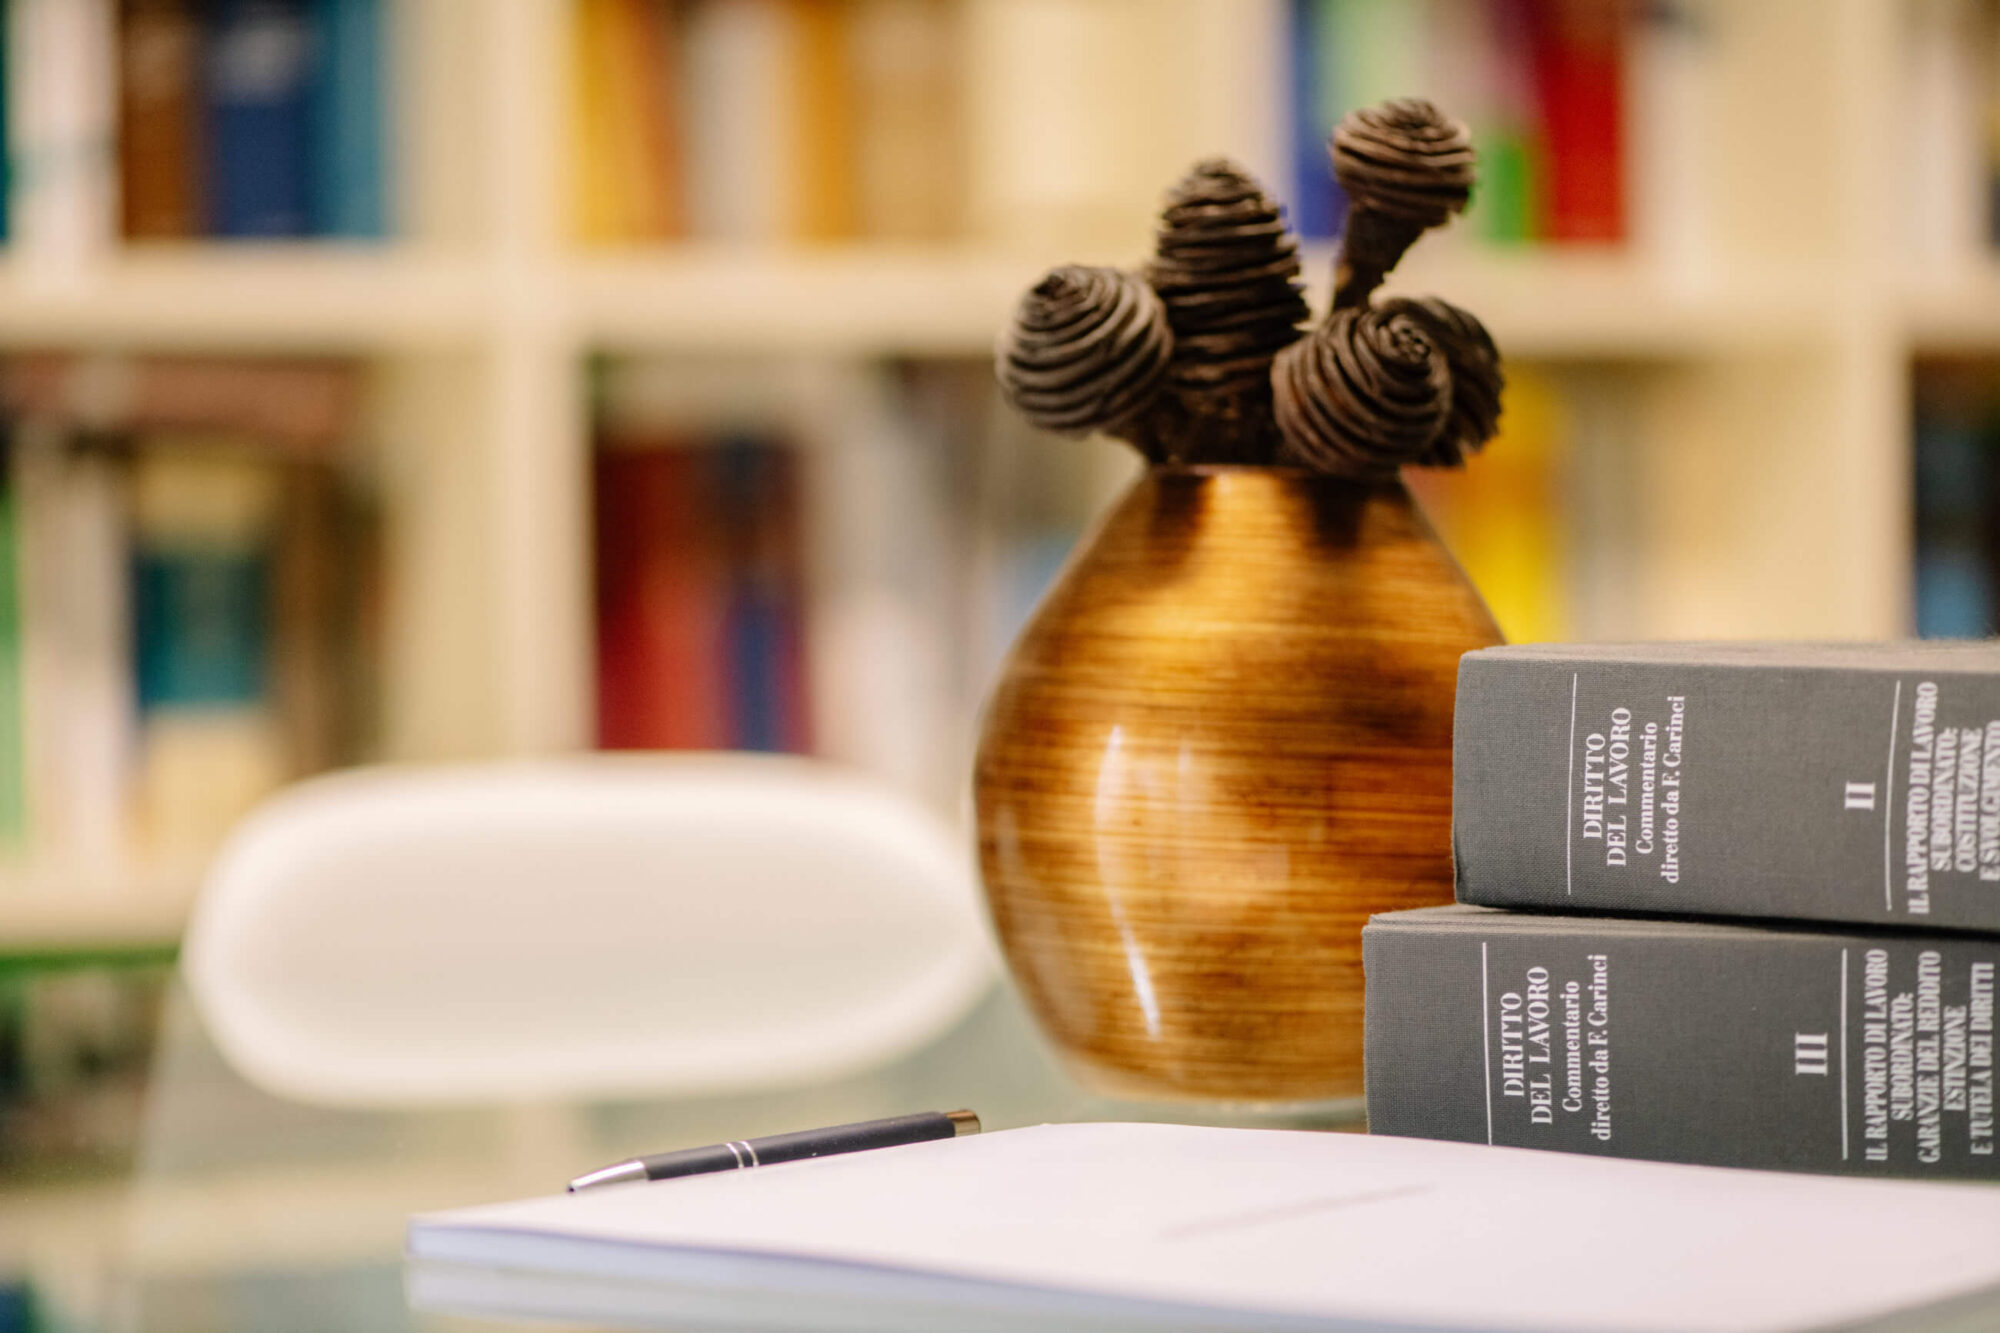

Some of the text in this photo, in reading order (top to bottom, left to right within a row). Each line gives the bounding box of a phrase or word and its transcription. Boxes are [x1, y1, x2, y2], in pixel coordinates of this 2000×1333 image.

[1583, 733, 1606, 839] DIRITTO
[1607, 707, 1631, 866] DEL LAVORO
[1635, 722, 1658, 854] Commentario
[1661, 696, 1685, 884] diretto da F. Carinci
[1844, 781, 1875, 810] II
[1906, 682, 1938, 914] IL RAPPORTO DI LAVORO
[1930, 727, 1958, 872] SUBORDINATO:
[1955, 728, 1983, 873] COSTITUZIONE
[1979, 865, 2000, 881] E
[1501, 992, 1524, 1097] DIRITTO
[1527, 966, 1552, 1125] DEL LAVORO
[1560, 981, 1582, 1112] Commentario
[1587, 955, 1611, 1140] diretto da F. Carinci
[1795, 1032, 1828, 1076] III
[1864, 949, 1888, 1161] IL RAPPORTO DI LAVORO
[1890, 992, 1914, 1120] SUBORDINATO:
[1916, 951, 1941, 1163] GARANZIE DEL REDDITO
[1943, 1005, 1967, 1111] ESTINZIONE
[1969, 963, 1994, 1154] E TUTELA DEI DIRITTI
